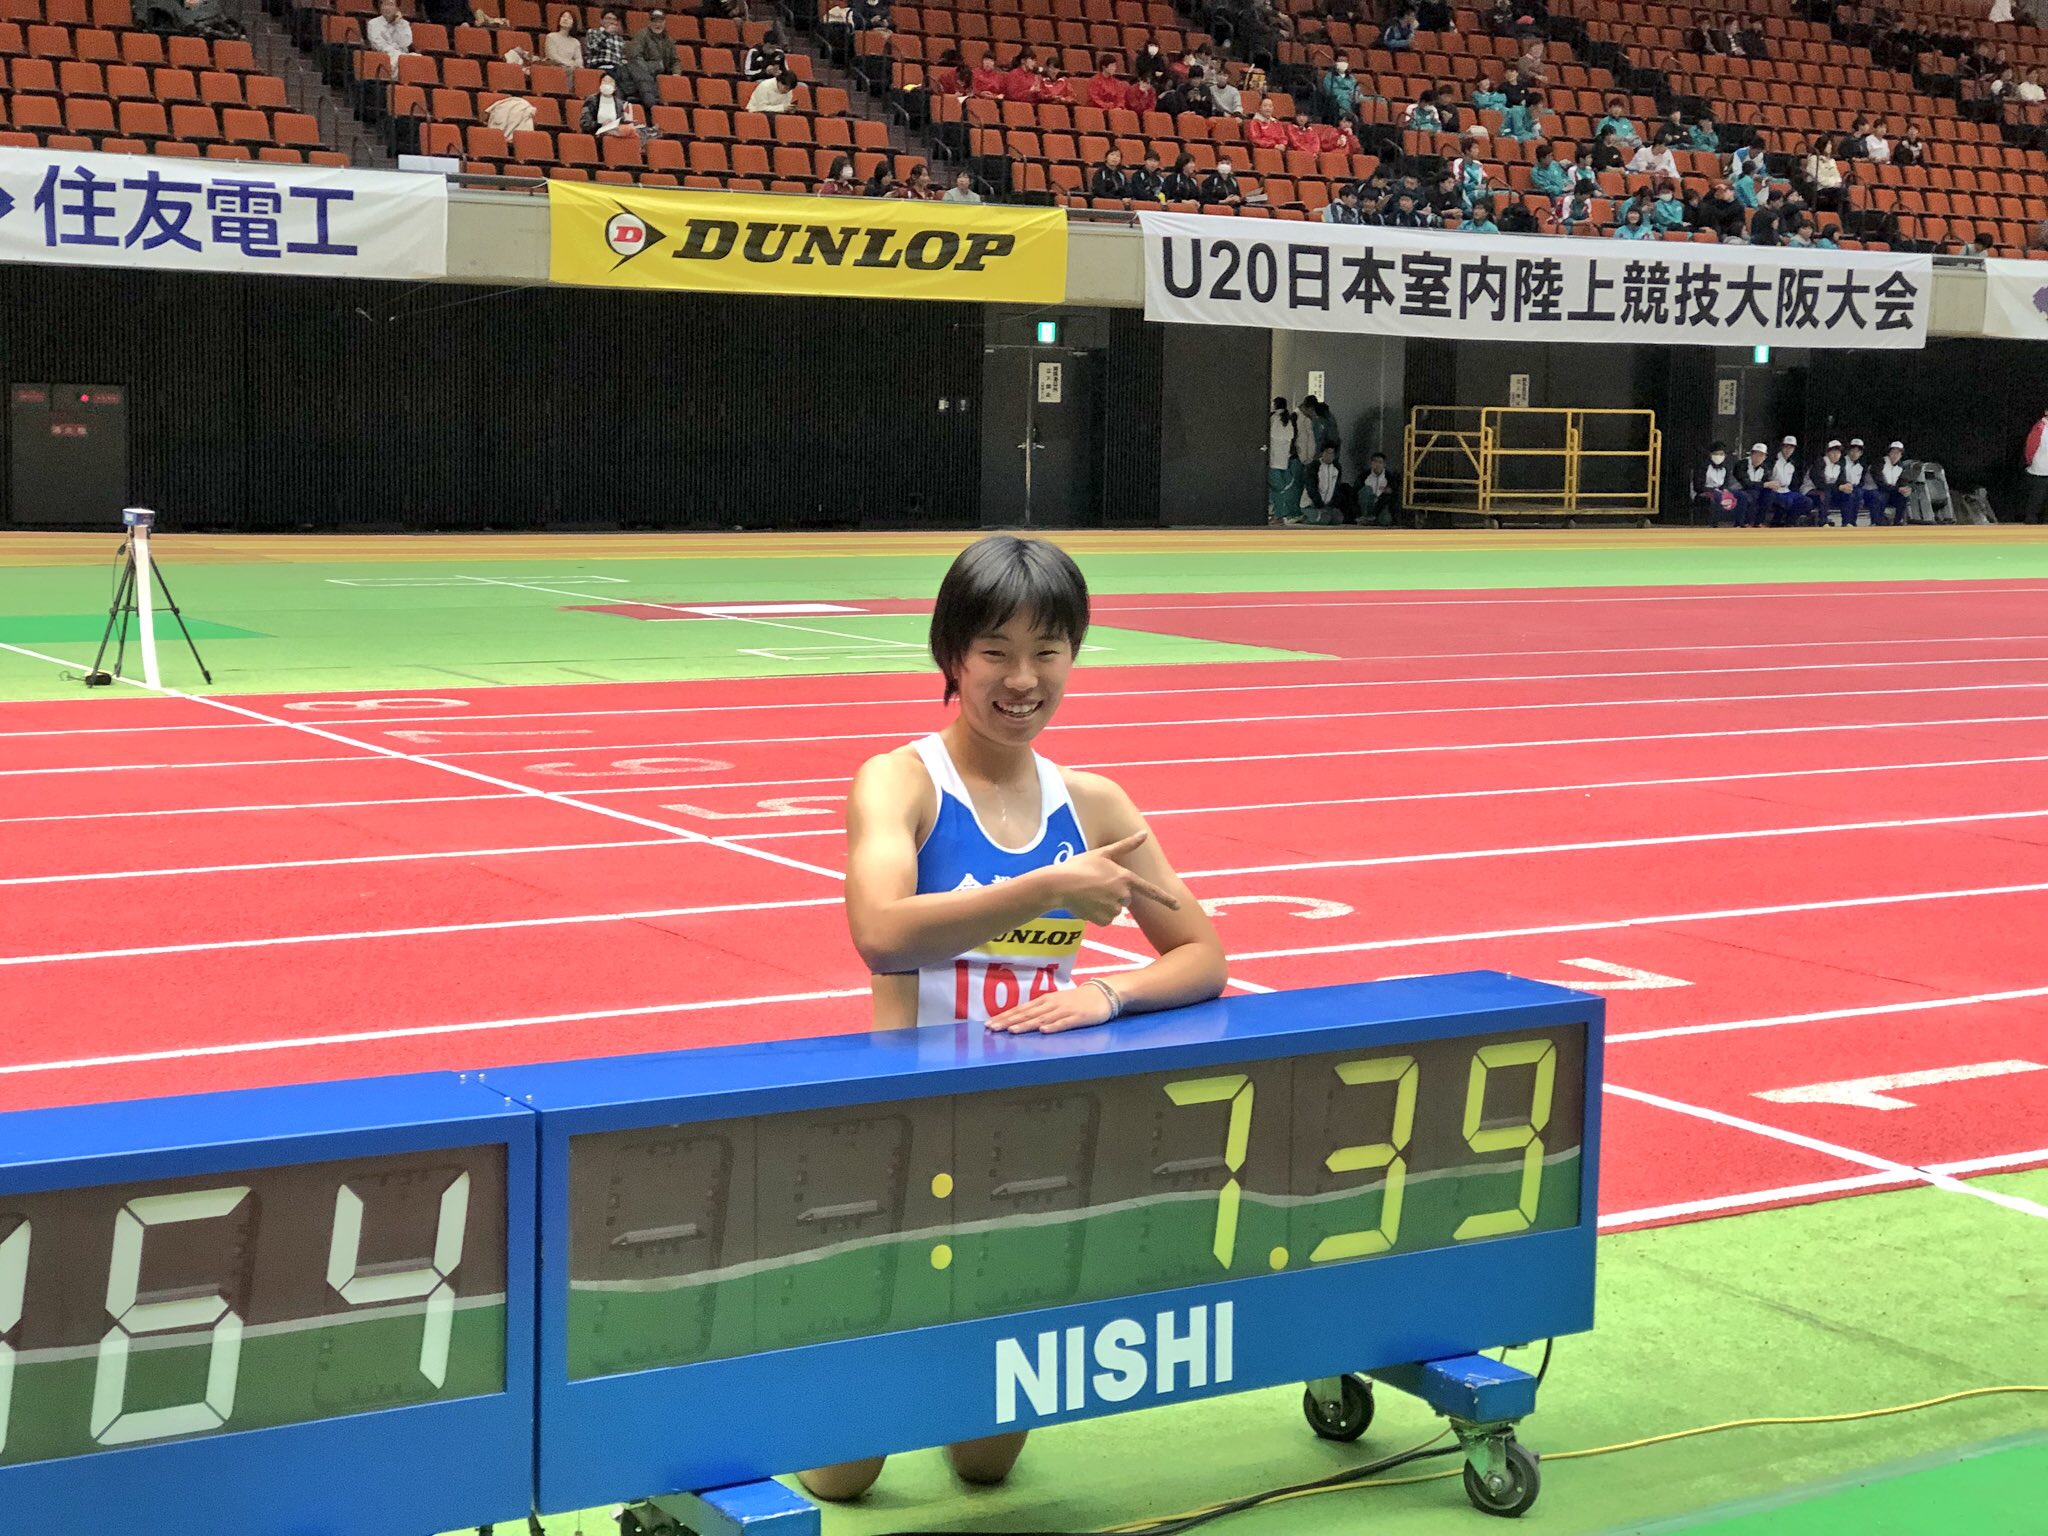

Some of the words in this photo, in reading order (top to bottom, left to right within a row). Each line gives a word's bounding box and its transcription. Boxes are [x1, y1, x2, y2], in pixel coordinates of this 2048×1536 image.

[35, 165, 359, 259] 住友電工
[672, 218, 1016, 272] DUNLOP
[1162, 237, 1919, 331] U20日本室内陸上競技大阪大会
[1163, 1038, 1557, 1271] 7.39
[995, 1301, 1235, 1425] NISHI
